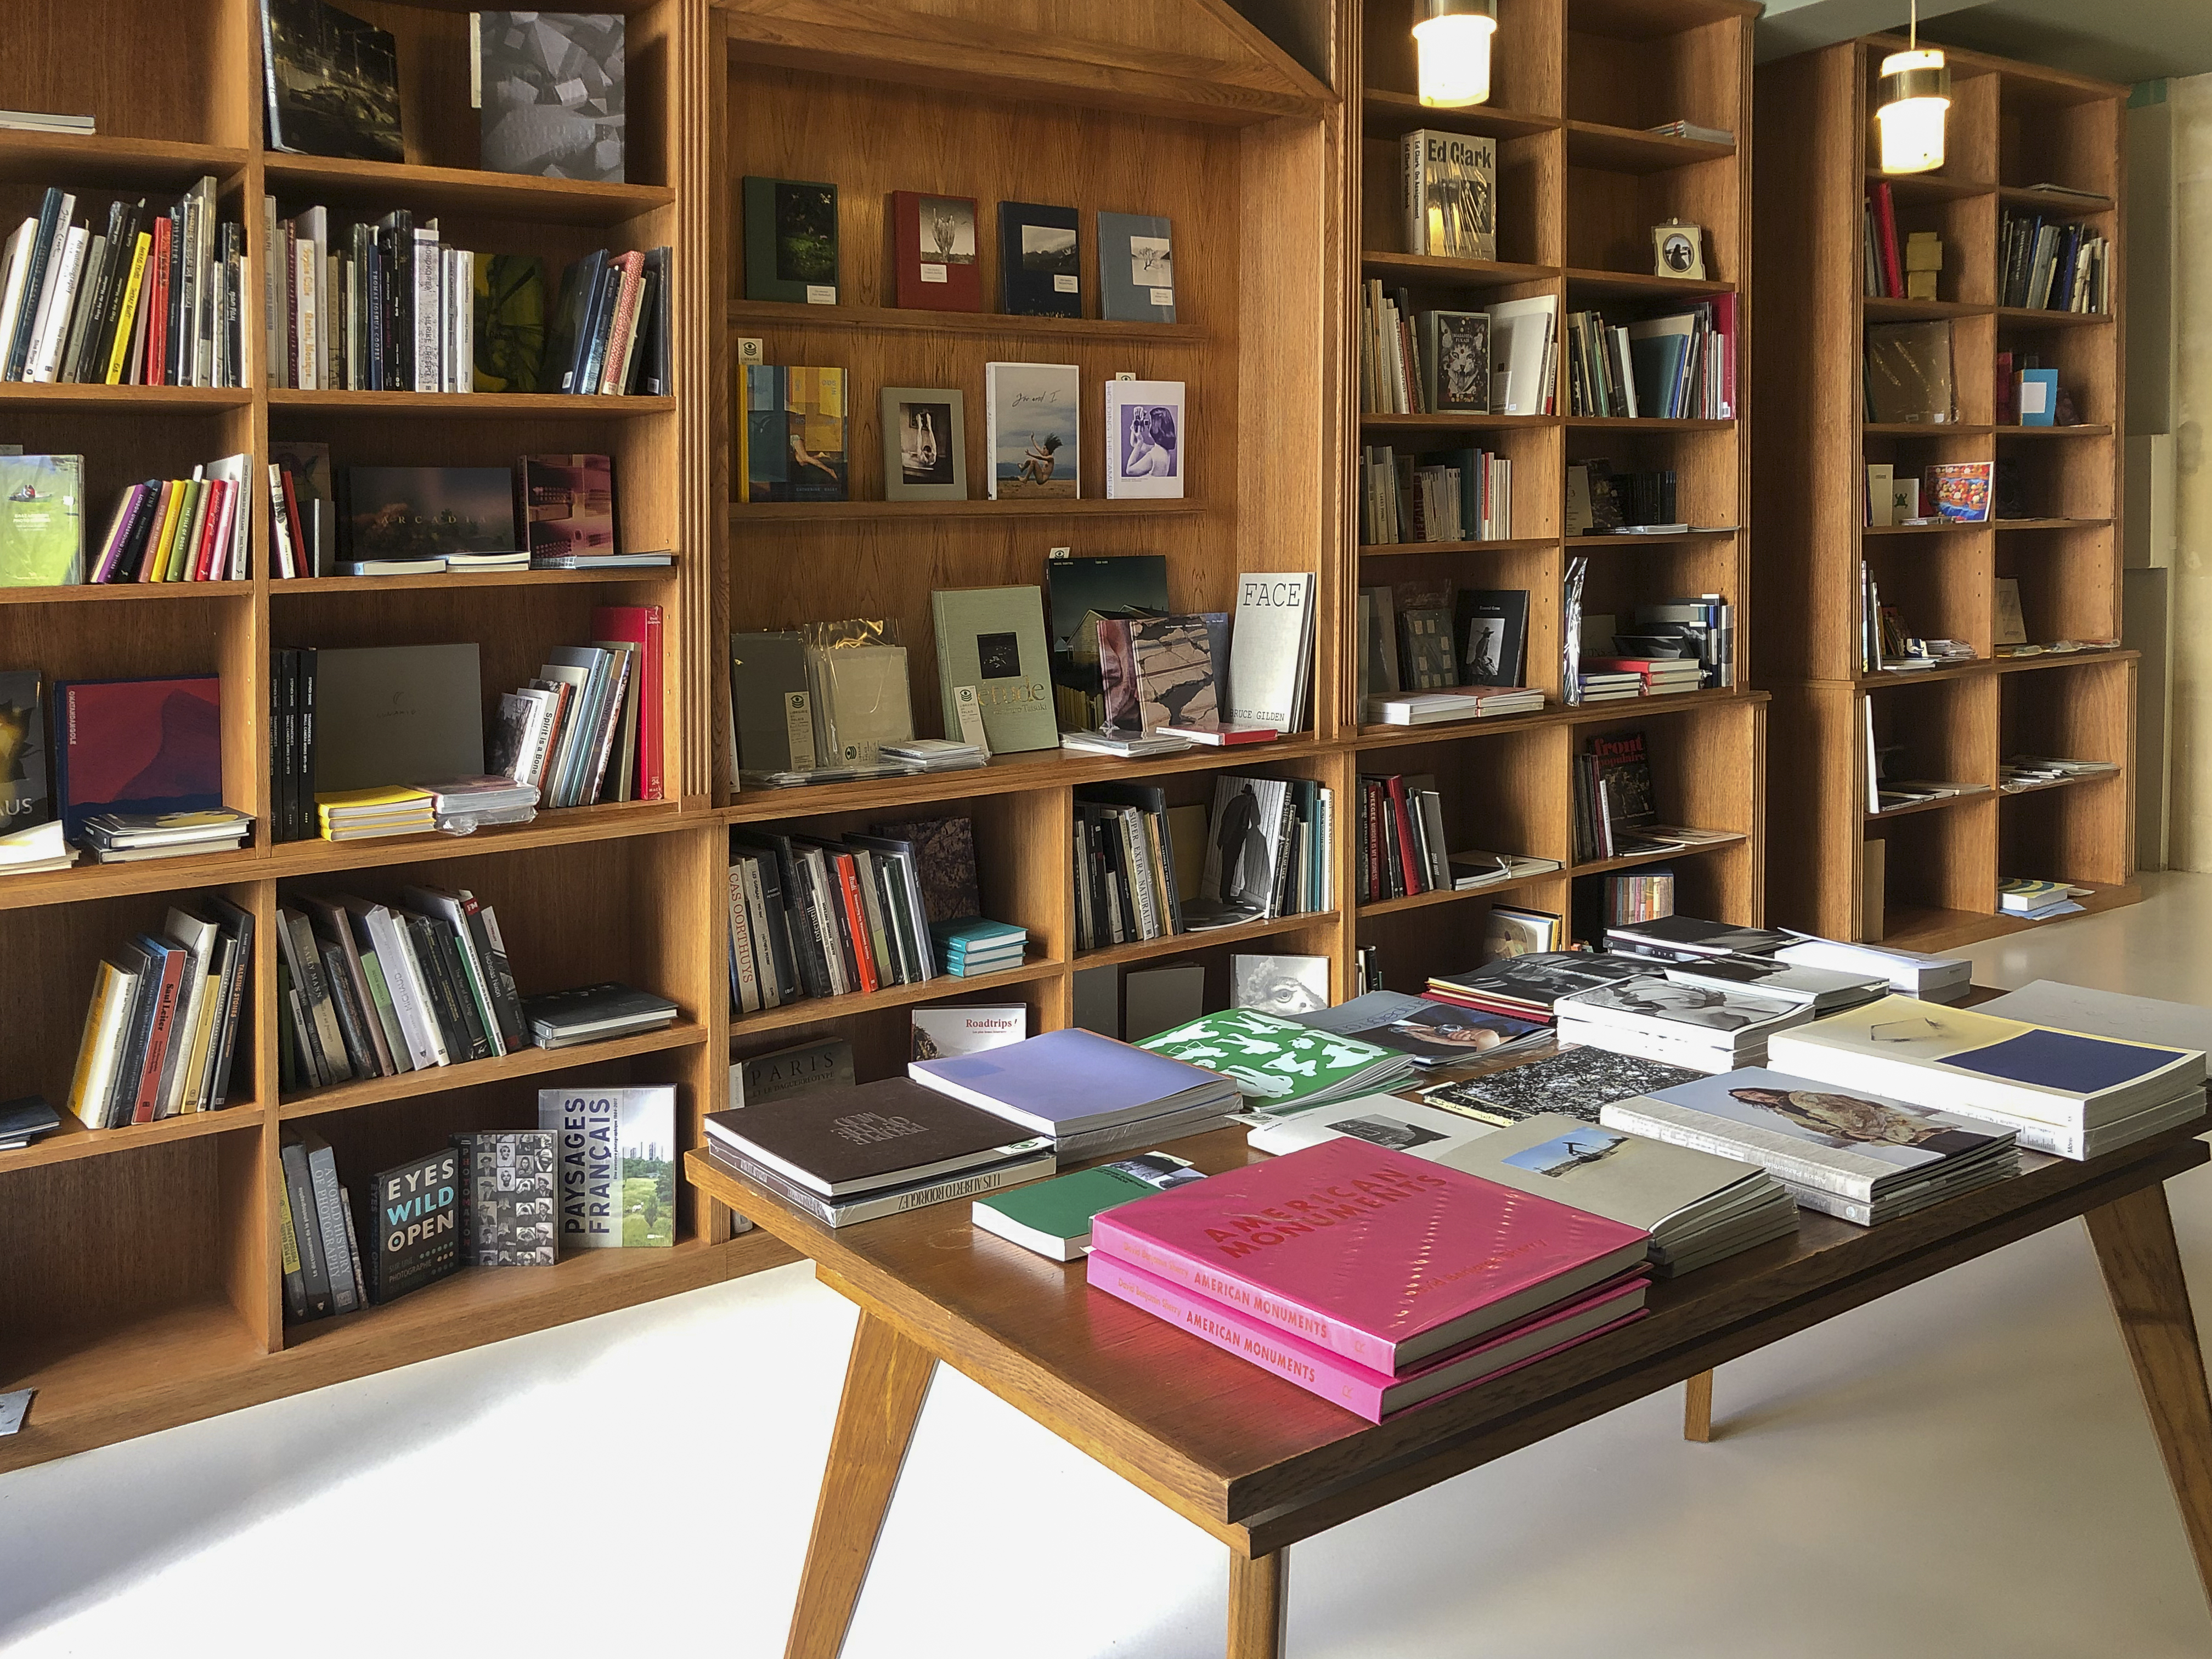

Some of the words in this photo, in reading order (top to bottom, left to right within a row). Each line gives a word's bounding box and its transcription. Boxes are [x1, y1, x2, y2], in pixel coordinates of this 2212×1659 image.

[1404, 143, 1409, 151] Ed
[1414, 140, 1420, 149] Ed
[1427, 138, 1447, 163] Ed
[1450, 141, 1492, 169] Clark
[1414, 171, 1420, 180] On
[76, 240, 83, 249] An
[65, 249, 81, 294] autobiography
[300, 249, 312, 274] Sophie
[304, 276, 312, 296] Calle
[1395, 330, 1404, 364] Friedlander
[1032, 391, 1046, 402] and
[1049, 390, 1060, 403] I
[133, 494, 144, 514] LONDON
[146, 487, 158, 508] TWINS
[119, 513, 136, 548] UNDERGROUND
[110, 547, 122, 569] 1970-1980
[1243, 583, 1301, 606] FACE
[1021, 703, 1047, 711] Tatsuki
[1230, 709, 1252, 718] BRUCE
[1256, 710, 1284, 721] GILDEN
[540, 712, 552, 735] Spirit
[1594, 735, 1643, 758] front
[531, 753, 541, 775] Bone
[1128, 811, 1139, 840] SUPER
[1133, 845, 1144, 875] EXTRA
[729, 872, 741, 901] CAS
[848, 875, 857, 891] Rudi
[466, 901, 478, 911] FM
[1138, 879, 1151, 924] NATURAL!
[806, 905, 821, 942] totenstill
[733, 903, 753, 983] OORTHUYS
[234, 963, 245, 991] TALKING
[302, 945, 315, 970] SALLY
[309, 972, 323, 998] MANN
[484, 951, 496, 979] Nicholas
[492, 978, 502, 997] Nixon
[163, 983, 174, 1004] Saul
[393, 972, 413, 1011] MICHAUD
[157, 1004, 170, 1031] Leiter
[230, 993, 240, 1018] STONES
[465, 1003, 474, 1017] Dog
[966, 1018, 1012, 1029] Roadtrips
[751, 1052, 834, 1086] PARIS
[773, 1071, 834, 1091] DAGUERRÉOTYPE
[313, 1169, 325, 1186] OF
[324, 1166, 334, 1176] A
[564, 1097, 585, 1234] PAYSAGES
[589, 1098, 613, 1234] FRANÇAIS
[1762, 1160, 1802, 1177] Pazoumian
[1803, 1172, 1826, 1183] Alexis
[388, 1158, 454, 1201] EYES
[944, 1177, 984, 1198] ALBERTO
[981, 1173, 1001, 1189] LUIS
[298, 1187, 309, 1222] photographie
[325, 1176, 343, 1221] WORLD
[387, 1187, 454, 1226] WILD
[462, 1148, 470, 1246] PHOTOMATON
[895, 1186, 946, 1210] RODRIGUEZ
[1204, 1169, 1409, 1243] AMERICAN
[1219, 1175, 1447, 1258] MONUMENTS
[314, 1188, 342, 1278] PHOTOGRAPHY
[388, 1210, 454, 1254] OPEN
[306, 1237, 317, 1269] dictionnaire
[332, 1223, 352, 1273] HISTORY
[1124, 1242, 1140, 1255] David
[1142, 1250, 1167, 1267] Benjamin
[1170, 1261, 1188, 1277] Sherry
[388, 1259, 432, 1283] PHOTOGRAPHIE
[1118, 1278, 1134, 1293] David
[1136, 1286, 1160, 1304] Benjamin
[1162, 1299, 1181, 1317] Sherry
[1194, 1272, 1250, 1306] AMERICAN
[1254, 1297, 1327, 1338] MONUMENTS
[1187, 1311, 1240, 1346] AMERICAN
[1244, 1338, 1315, 1383] MONUMENTS
